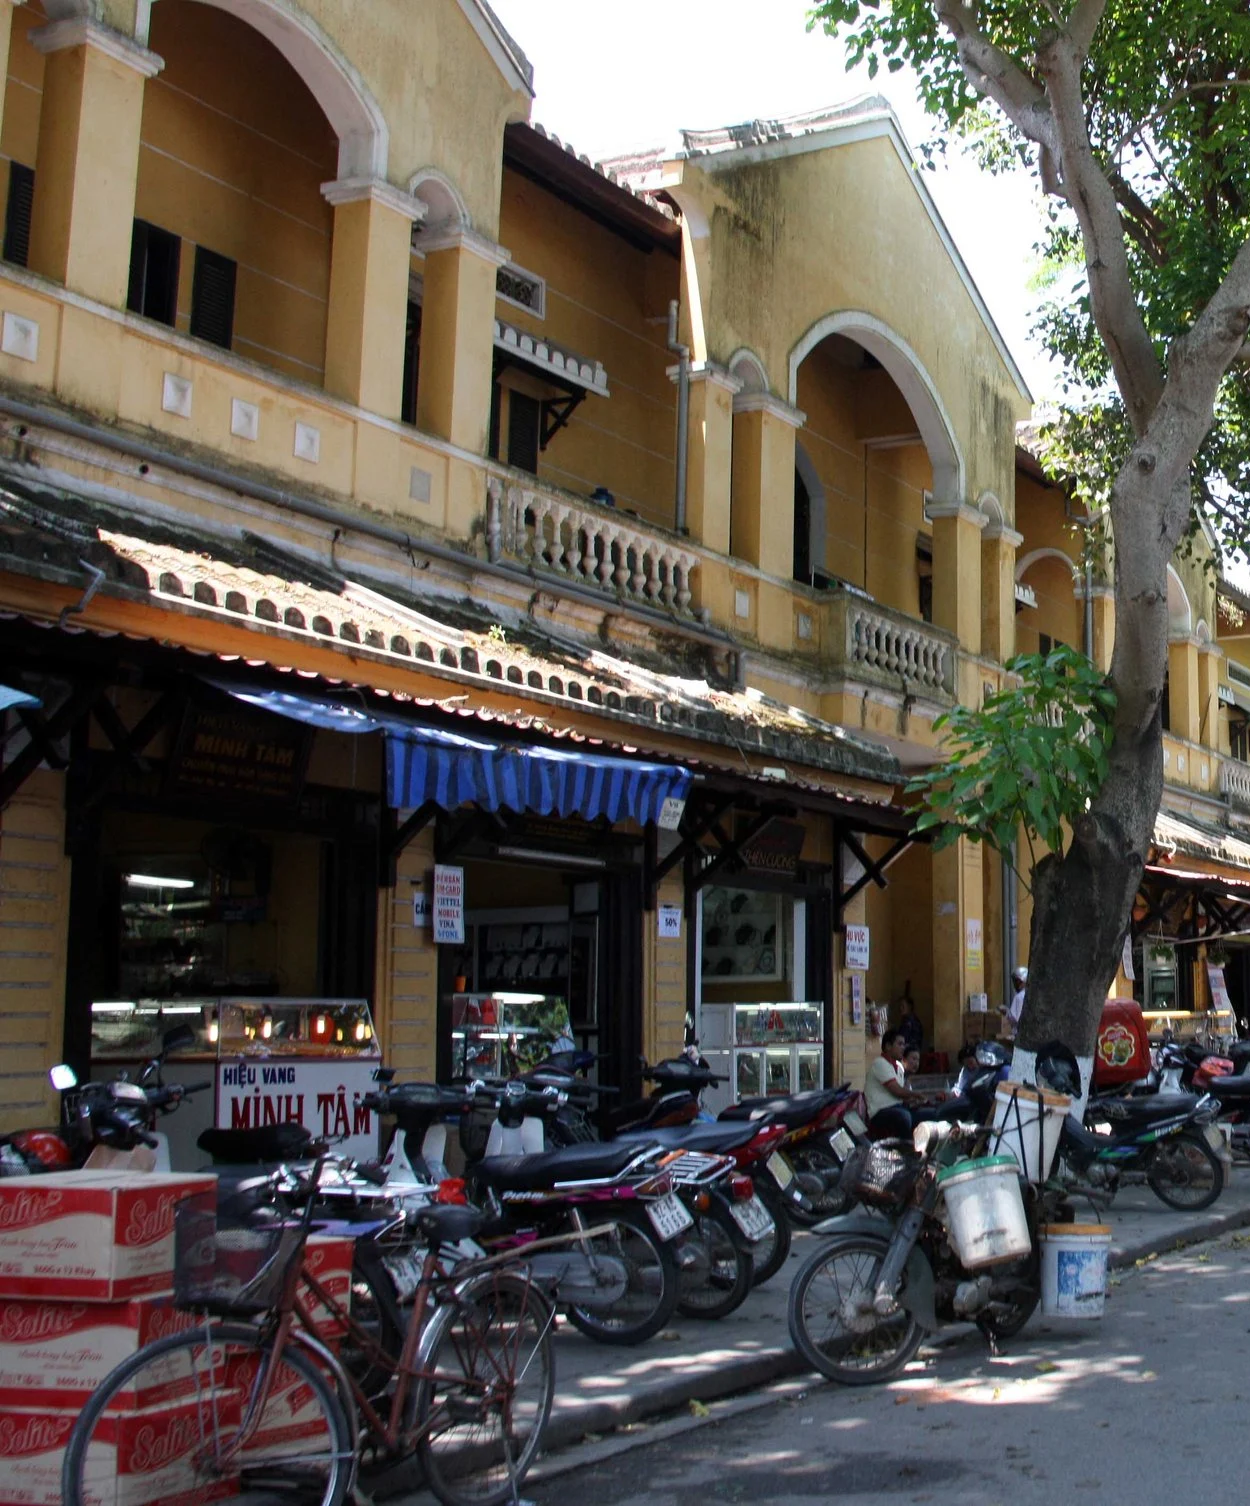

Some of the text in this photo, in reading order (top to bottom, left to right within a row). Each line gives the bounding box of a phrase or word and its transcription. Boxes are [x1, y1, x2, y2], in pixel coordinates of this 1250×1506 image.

[194, 732, 249, 758] MINH
[439, 919, 456, 929] VINA
[223, 1063, 296, 1089] HIỆU VANG
[316, 1083, 372, 1138] TÂM
